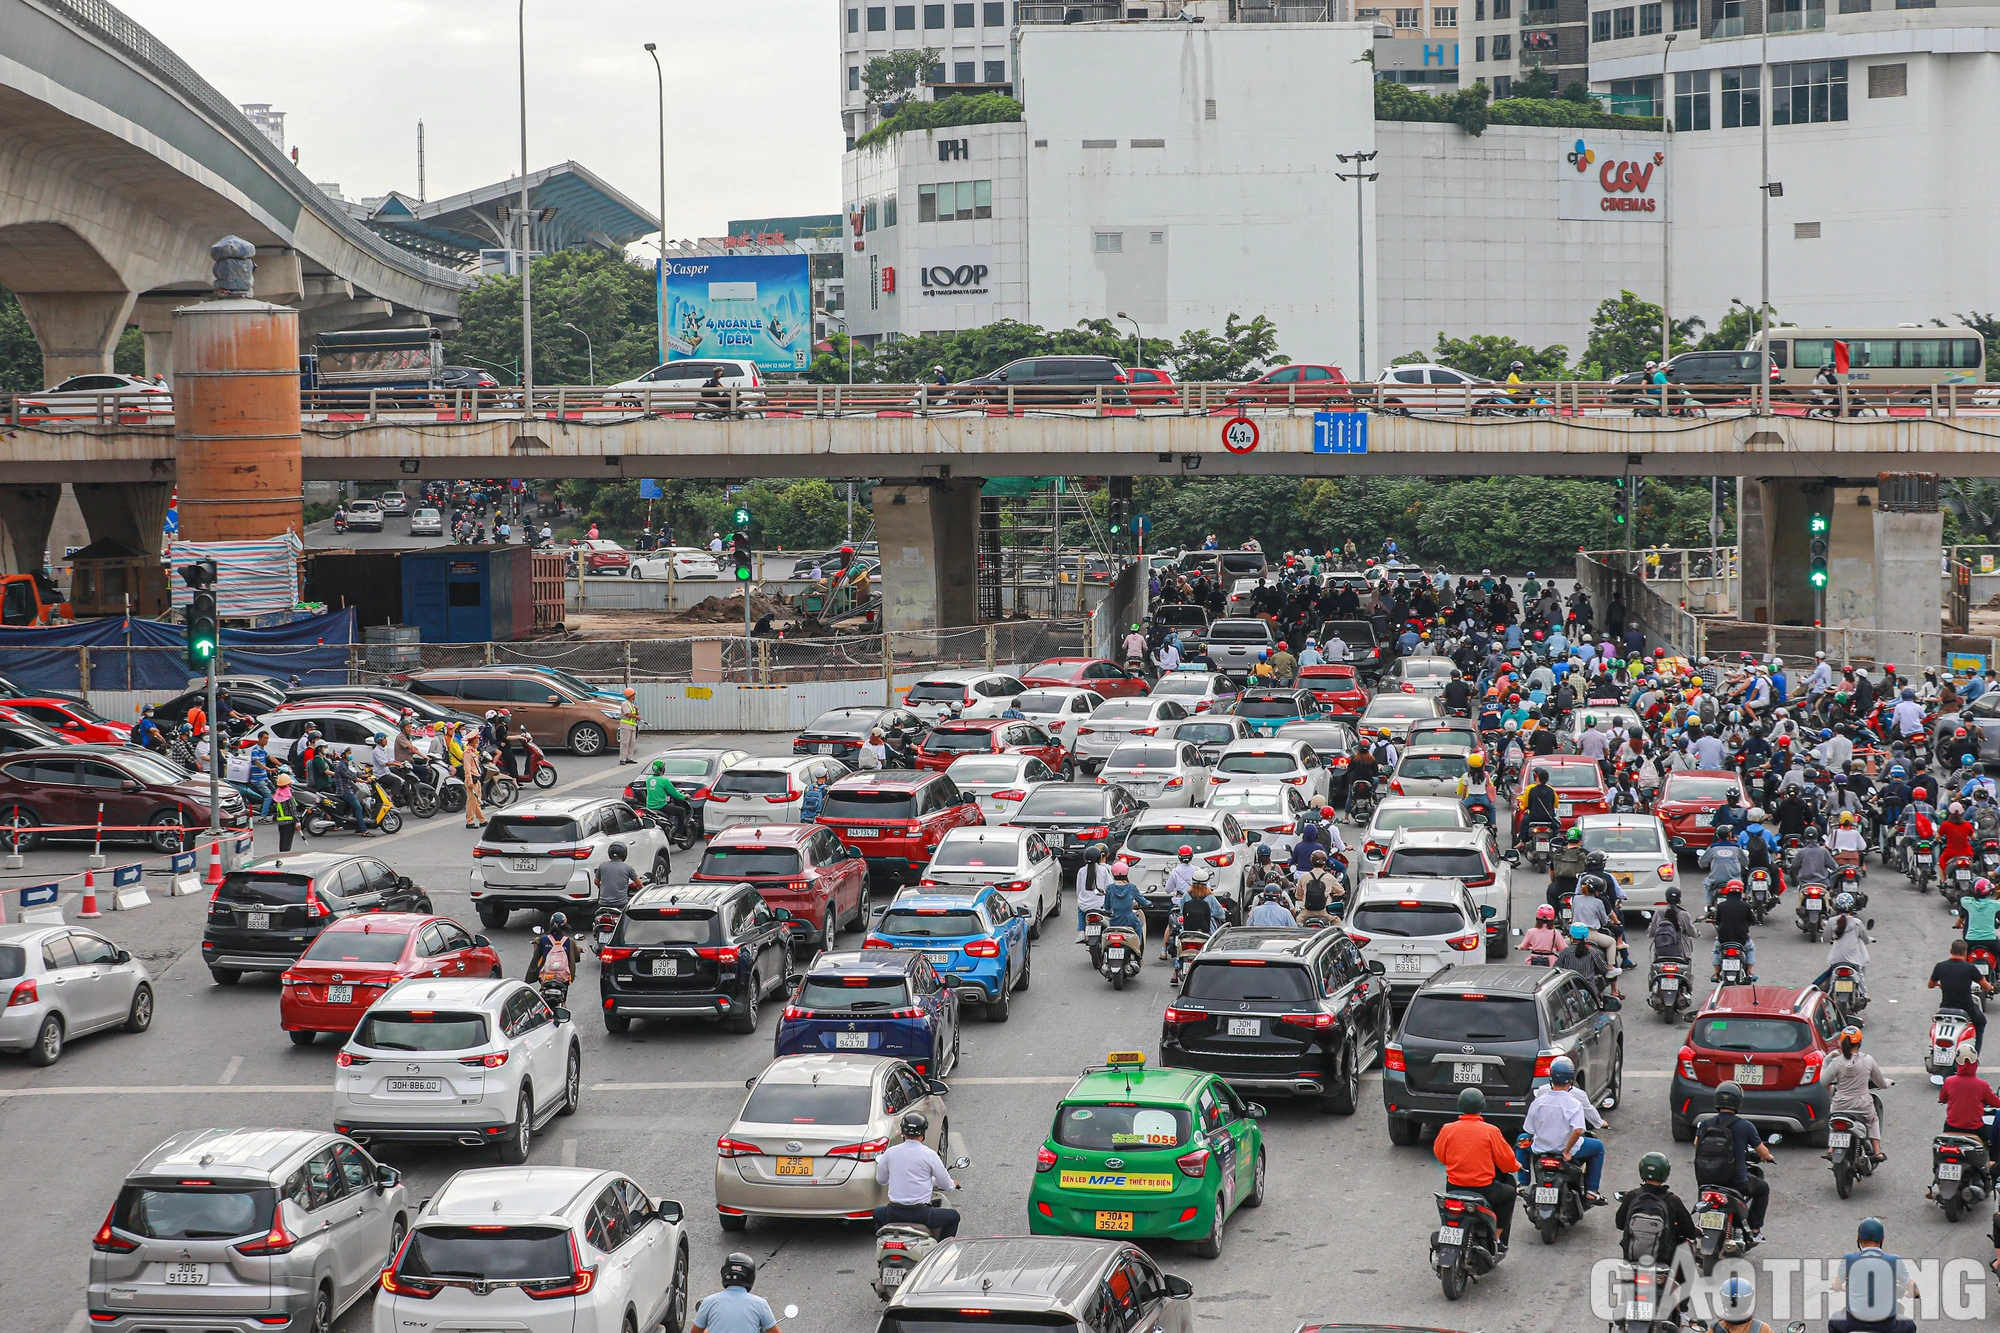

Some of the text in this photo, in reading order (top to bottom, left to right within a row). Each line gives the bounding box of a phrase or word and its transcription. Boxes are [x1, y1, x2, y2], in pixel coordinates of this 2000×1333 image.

[937, 138, 969, 161] IPH
[1600, 160, 1654, 192] CGV
[1600, 197, 1656, 212] CINEMAS
[672, 263, 709, 277] Casper
[921, 264, 988, 287] LOOP
[705, 318, 714, 329] 4
[717, 317, 748, 329] NGÀN
[717, 332, 753, 345] 1 ĐÊM
[1401, 955, 1414, 963] 30E
[653, 967, 676, 976] 879.02
[333, 986, 347, 994] 30G
[328, 994, 351, 1003] 405.03
[1232, 1027, 1257, 1035] 100.18
[1461, 1063, 1475, 1072] 30F
[1741, 1065, 1757, 1074] 30G
[1454, 1073, 1481, 1082] 839.04
[1146, 1134, 1178, 1146] 1055
[787, 1157, 803, 1165] 29E
[780, 1165, 809, 1174] 007.30
[1088, 1175, 1127, 1186] MPE
[1128, 1176, 1147, 1186] THIẾT
[1106, 1211, 1123, 1220] 30A
[1099, 1220, 1129, 1230] 352.42
[178, 1263, 197, 1272] 30G
[169, 1273, 203, 1283] 913.57
[402, 1320, 428, 1329] CR-V
